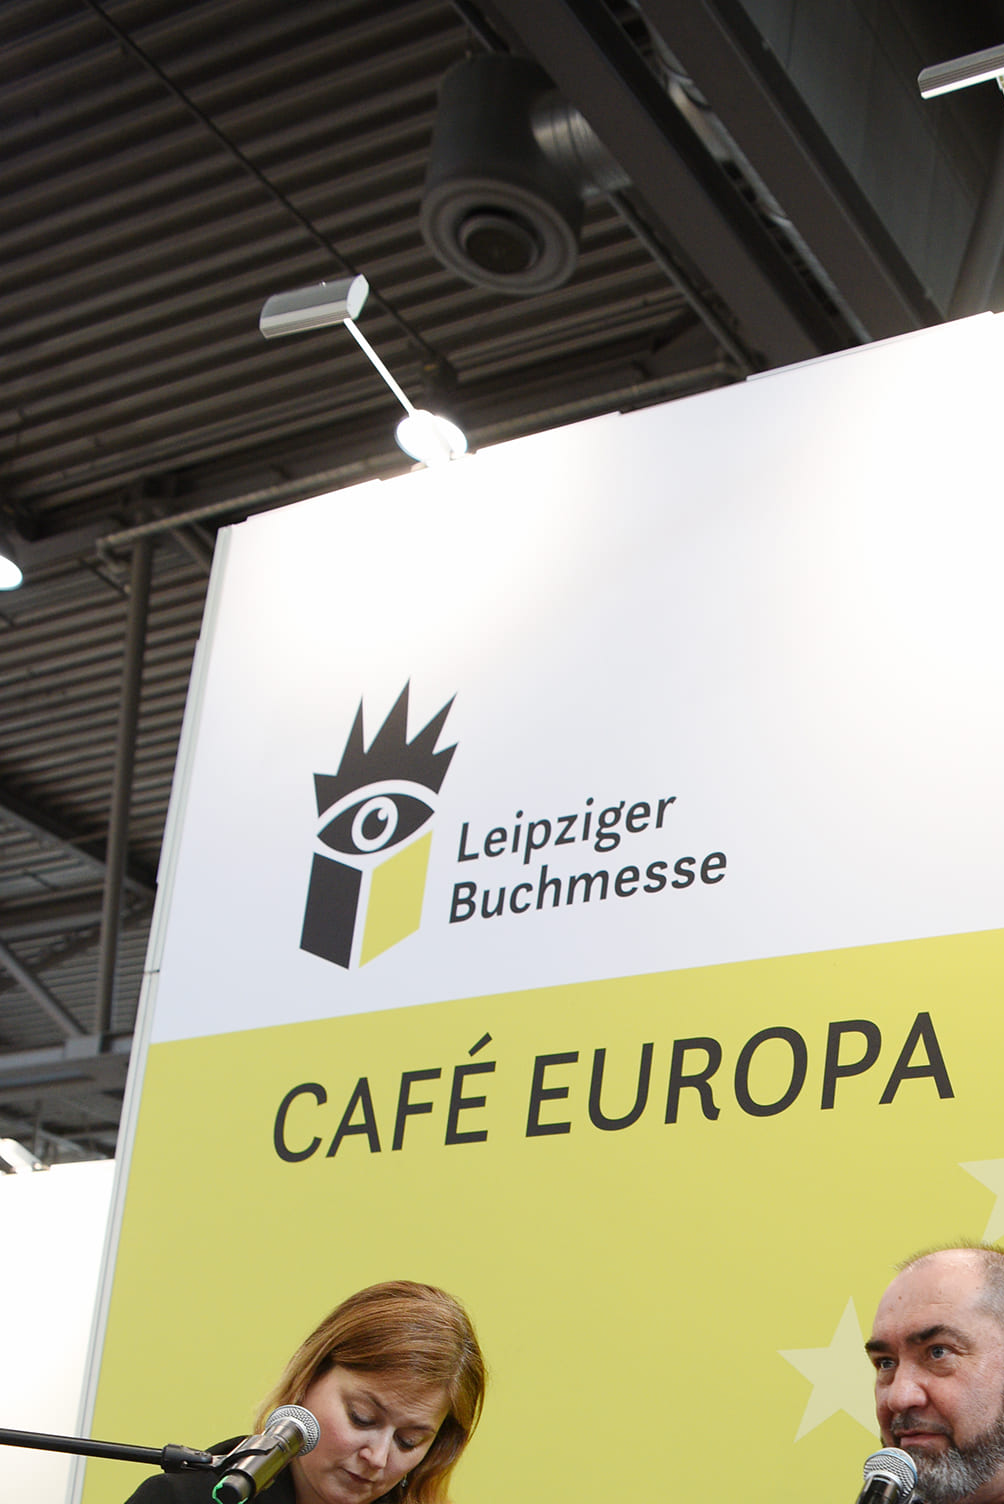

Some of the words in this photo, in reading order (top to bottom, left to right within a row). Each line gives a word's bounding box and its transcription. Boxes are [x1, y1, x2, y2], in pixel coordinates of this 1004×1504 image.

[456, 794, 678, 865] Leipziger
[448, 850, 729, 925] Buchmesse
[272, 1031, 498, 1164] CAFÉ
[524, 1011, 956, 1139] EUROPA
